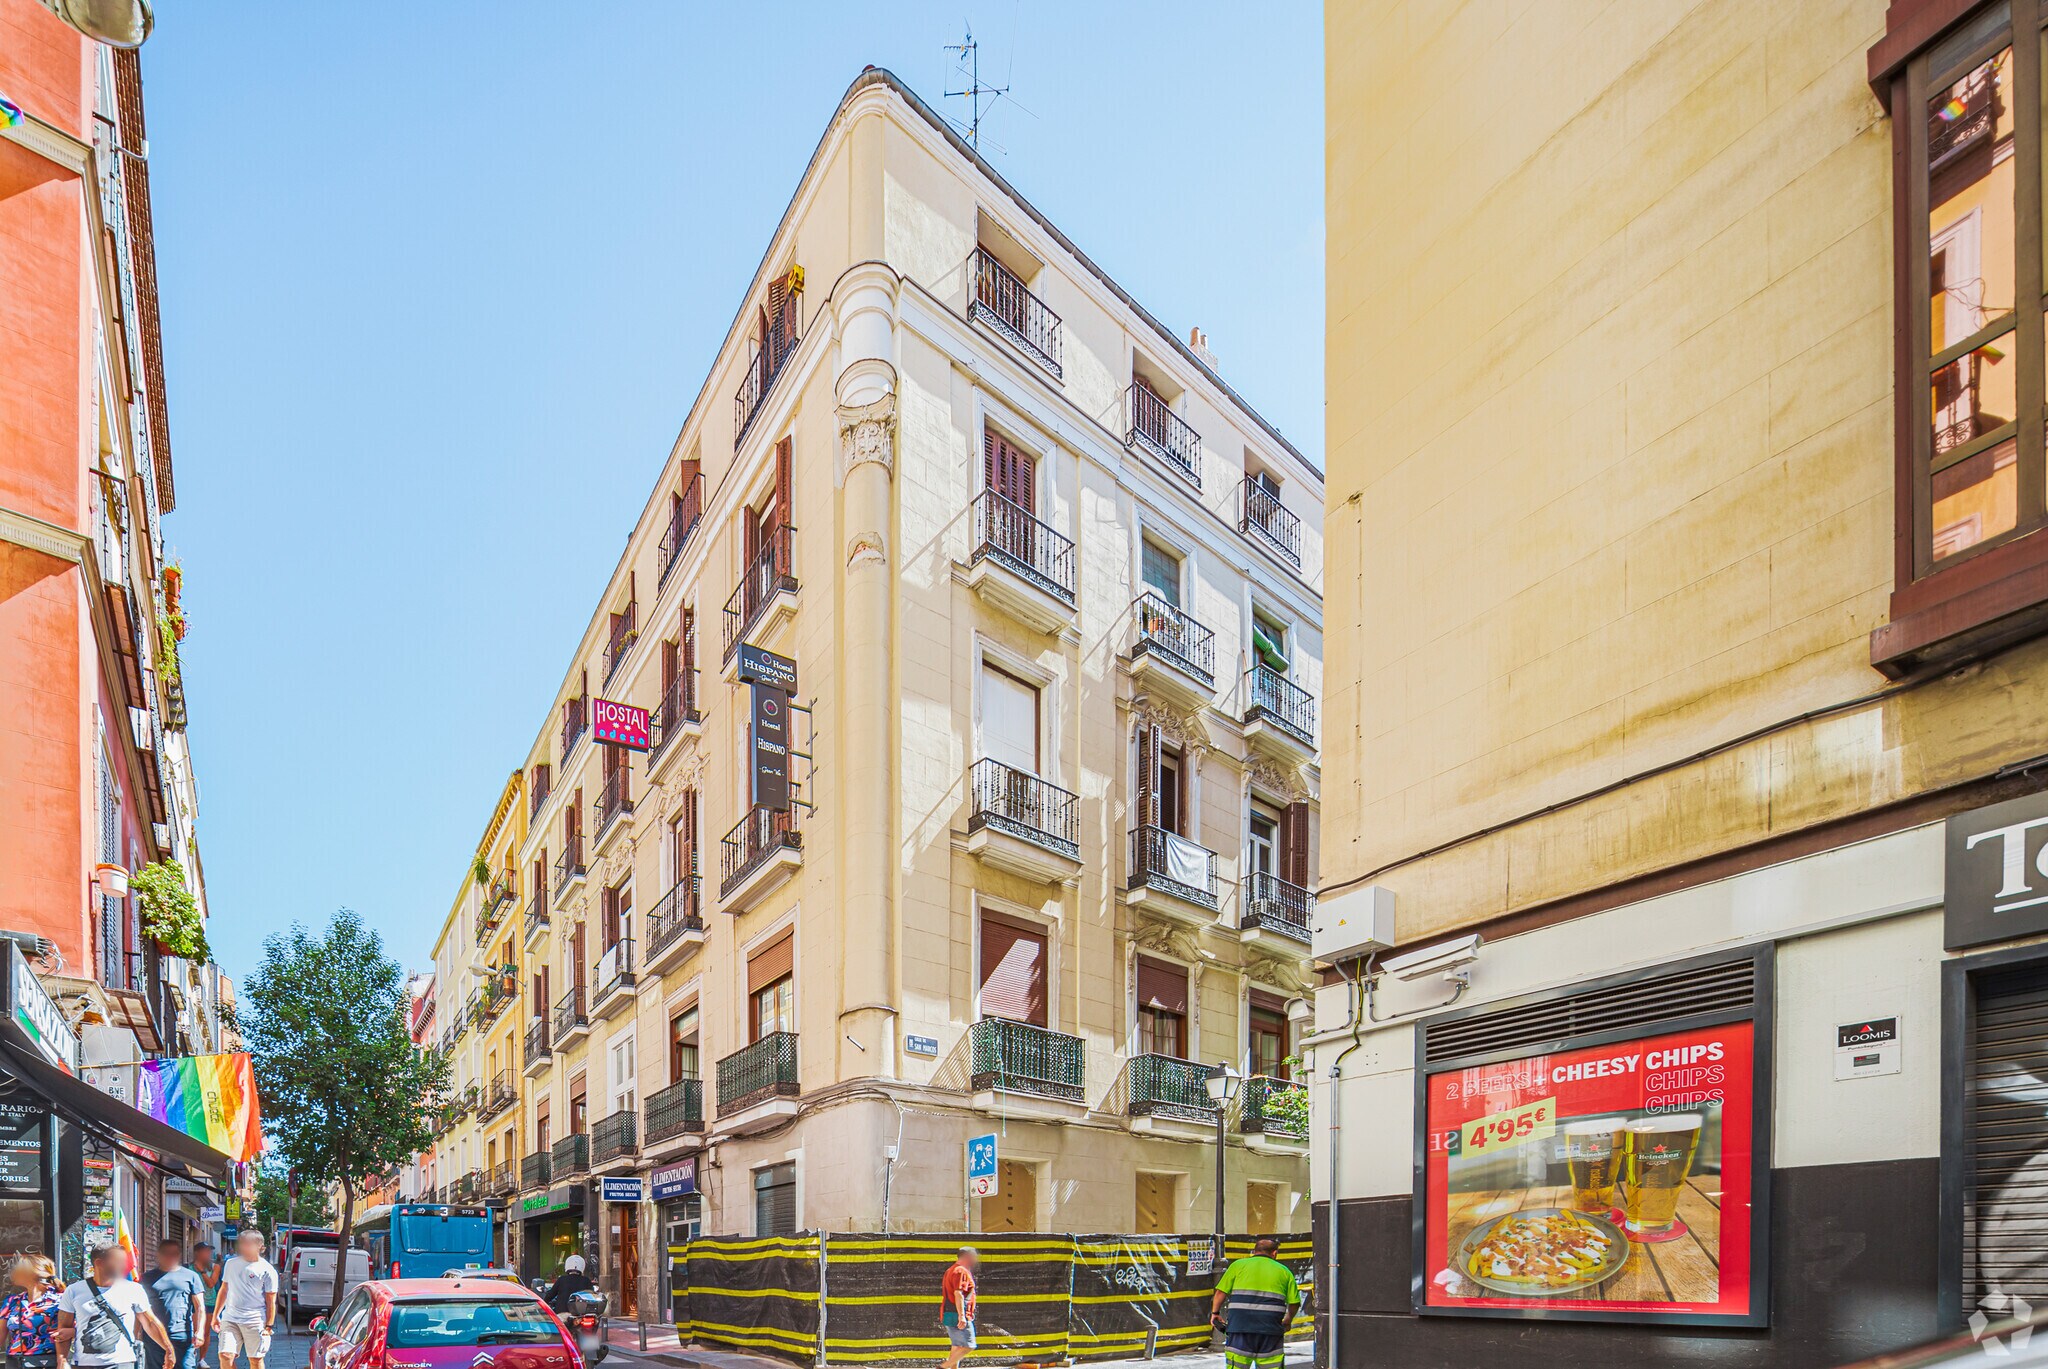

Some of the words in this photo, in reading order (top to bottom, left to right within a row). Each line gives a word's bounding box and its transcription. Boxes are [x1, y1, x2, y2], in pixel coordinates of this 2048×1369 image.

[743, 658, 796, 683] HISPANO
[597, 701, 648, 735] HOSTAL
[761, 719, 781, 731] Hostal
[599, 729, 645, 745] odesa
[757, 737, 786, 756] HISPANO
[1966, 816, 2048, 898] T
[1843, 1030, 1891, 1043] LOOMIS
[1446, 1082, 1459, 1100] 2
[1465, 1071, 1531, 1097] BEERS
[1552, 1054, 1640, 1084] CHEESY
[1646, 1042, 1724, 1070] CHIPS
[1646, 1065, 1725, 1092] CHIPS
[1646, 1088, 1724, 1115] CHIPS
[1638, 1152, 1680, 1160] Heineken
[652, 1164, 693, 1187] ALIMENTACIÓN
[604, 1181, 642, 1191] ALIMENTACIÓN
[440, 1207, 449, 1217] 3
[393, 1359, 432, 1368] CITROËN
